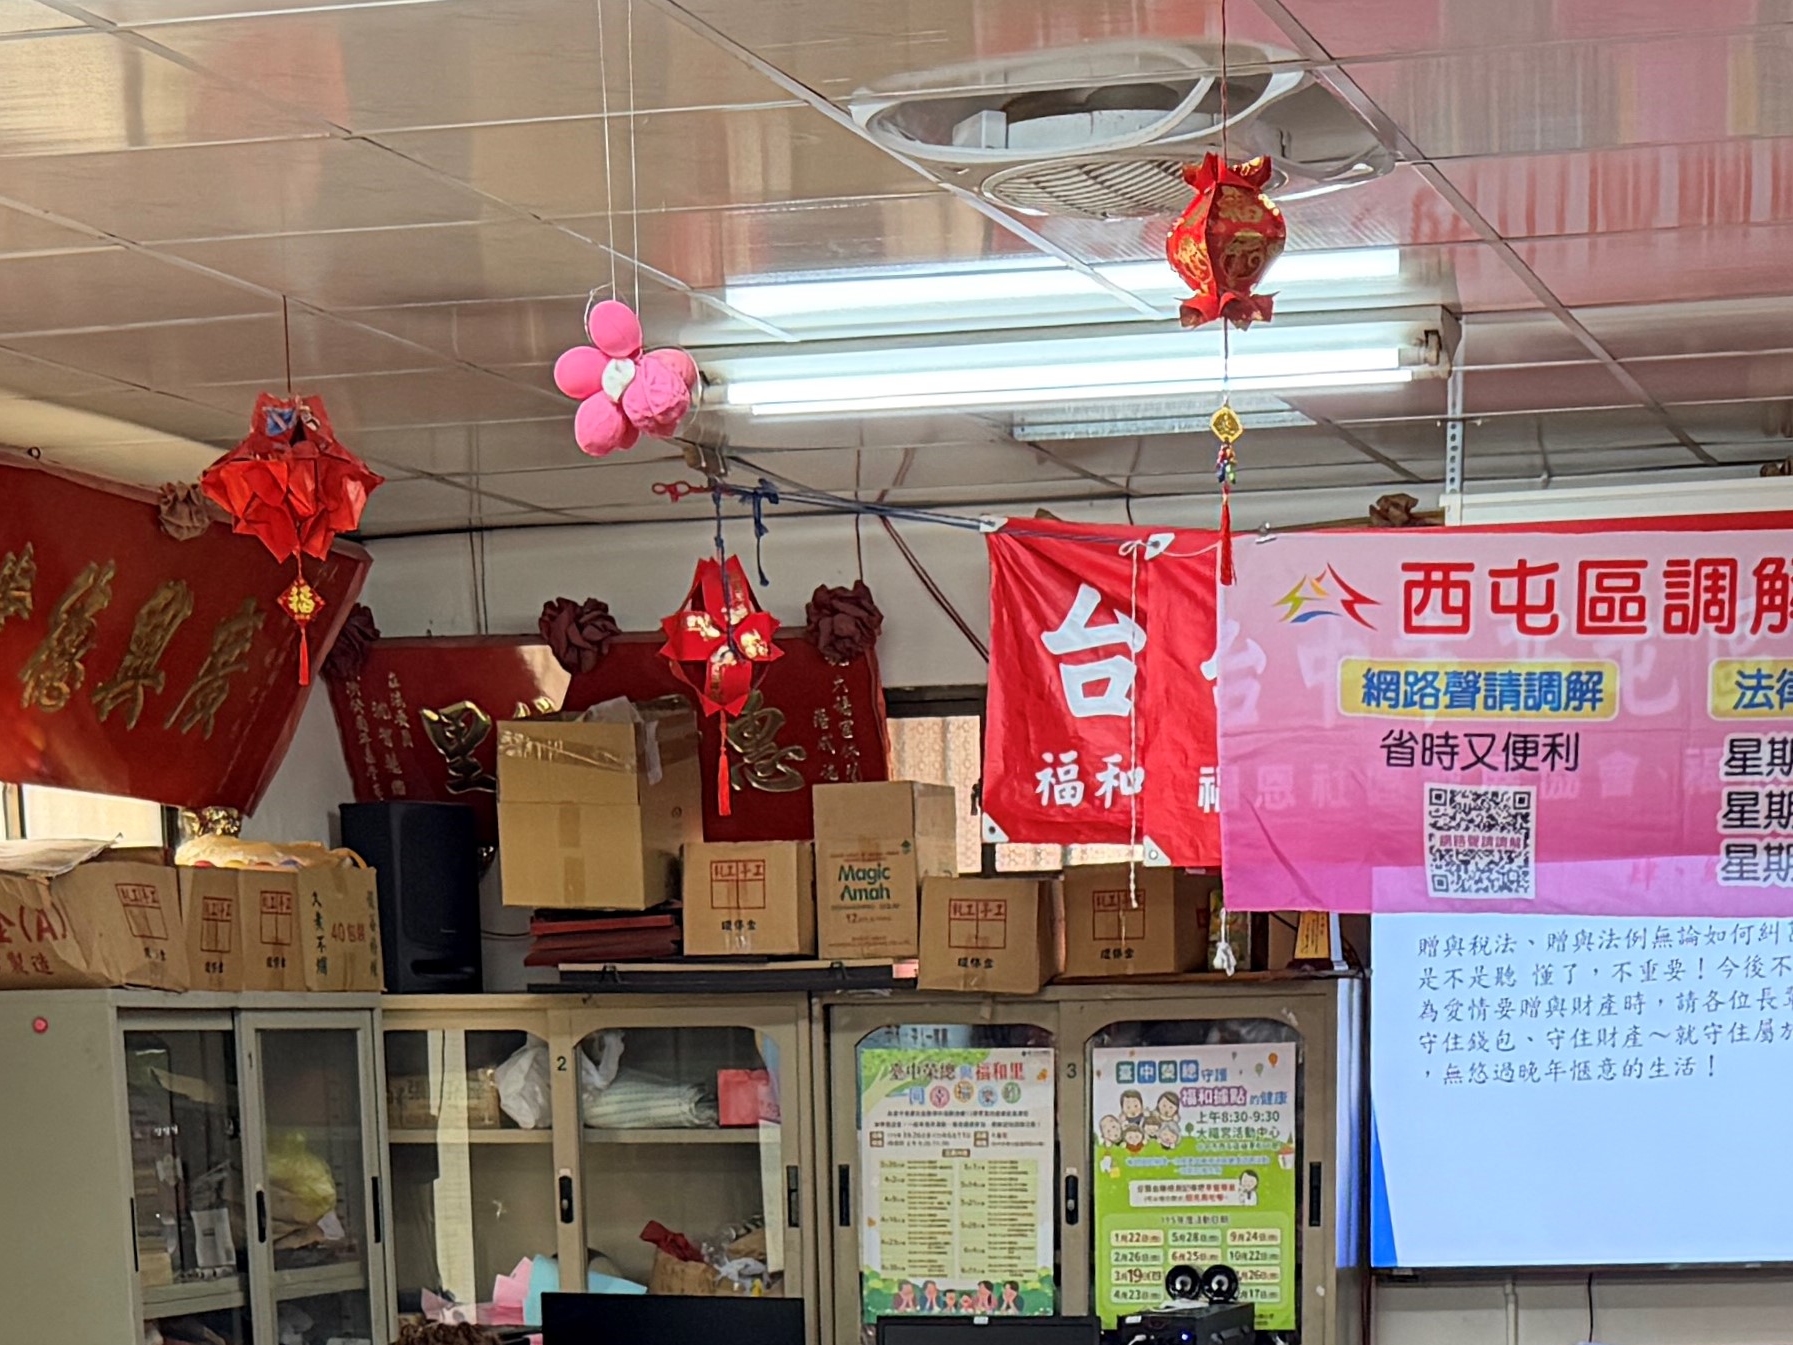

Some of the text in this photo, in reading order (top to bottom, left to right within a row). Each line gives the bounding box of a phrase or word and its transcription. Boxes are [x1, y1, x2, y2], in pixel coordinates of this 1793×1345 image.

[1041, 582, 1147, 718] 台
[1361, 667, 1605, 714] 網路聲請調解
[1380, 729, 1580, 773] 省時又便利
[1035, 750, 1145, 809] 福和
[837, 864, 891, 885] Magic
[840, 883, 891, 901] Amah
[557, 1056, 567, 1072] 2
[975, 1062, 1025, 1082] 福和里
[1066, 1062, 1077, 1079] 3
[1115, 1059, 1199, 1084] 臺中榮總
[1180, 1086, 1247, 1108] 福和據點
[1195, 1110, 1281, 1125] 上午8:30-9:30
